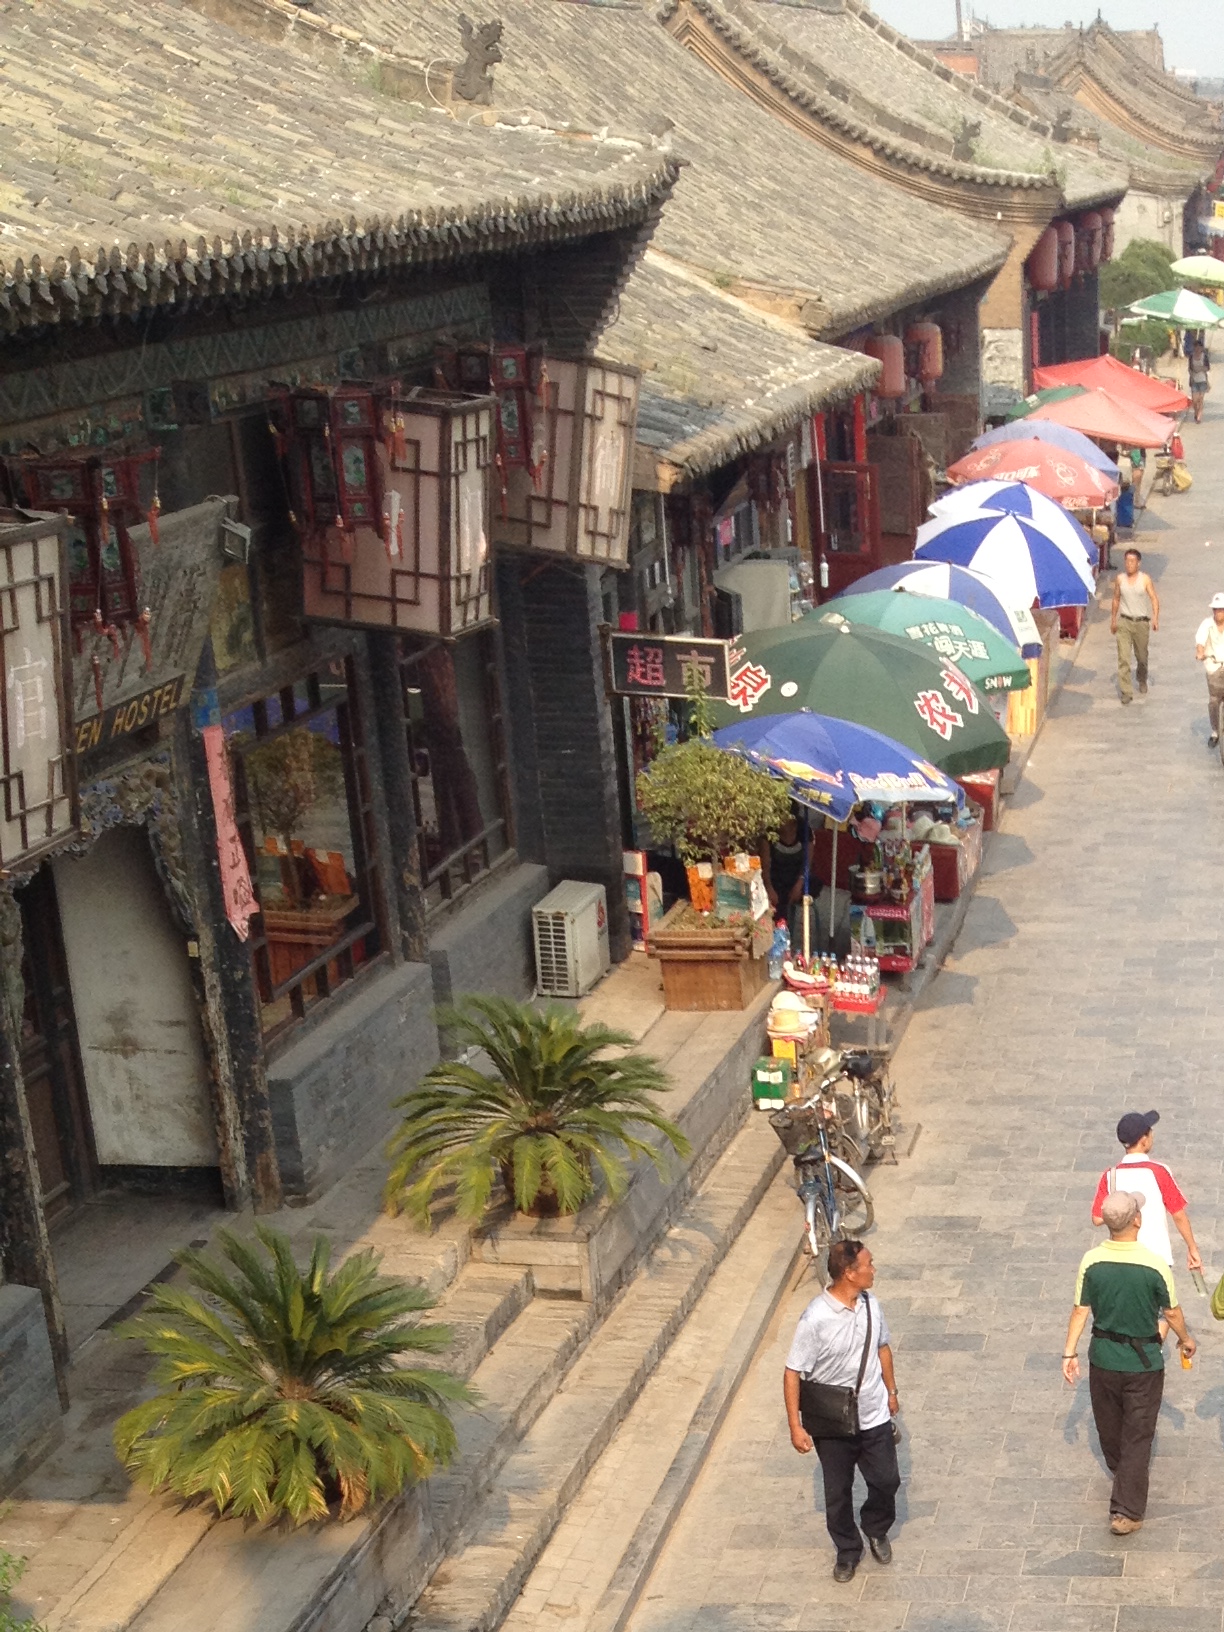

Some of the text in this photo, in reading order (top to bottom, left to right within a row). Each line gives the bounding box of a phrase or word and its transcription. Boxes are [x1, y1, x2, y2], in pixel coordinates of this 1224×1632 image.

[626, 644, 716, 688] 超市
[926, 635, 991, 662] 闯天涯
[7, 647, 48, 748] 官
[75, 682, 181, 754] EN HOSTEL
